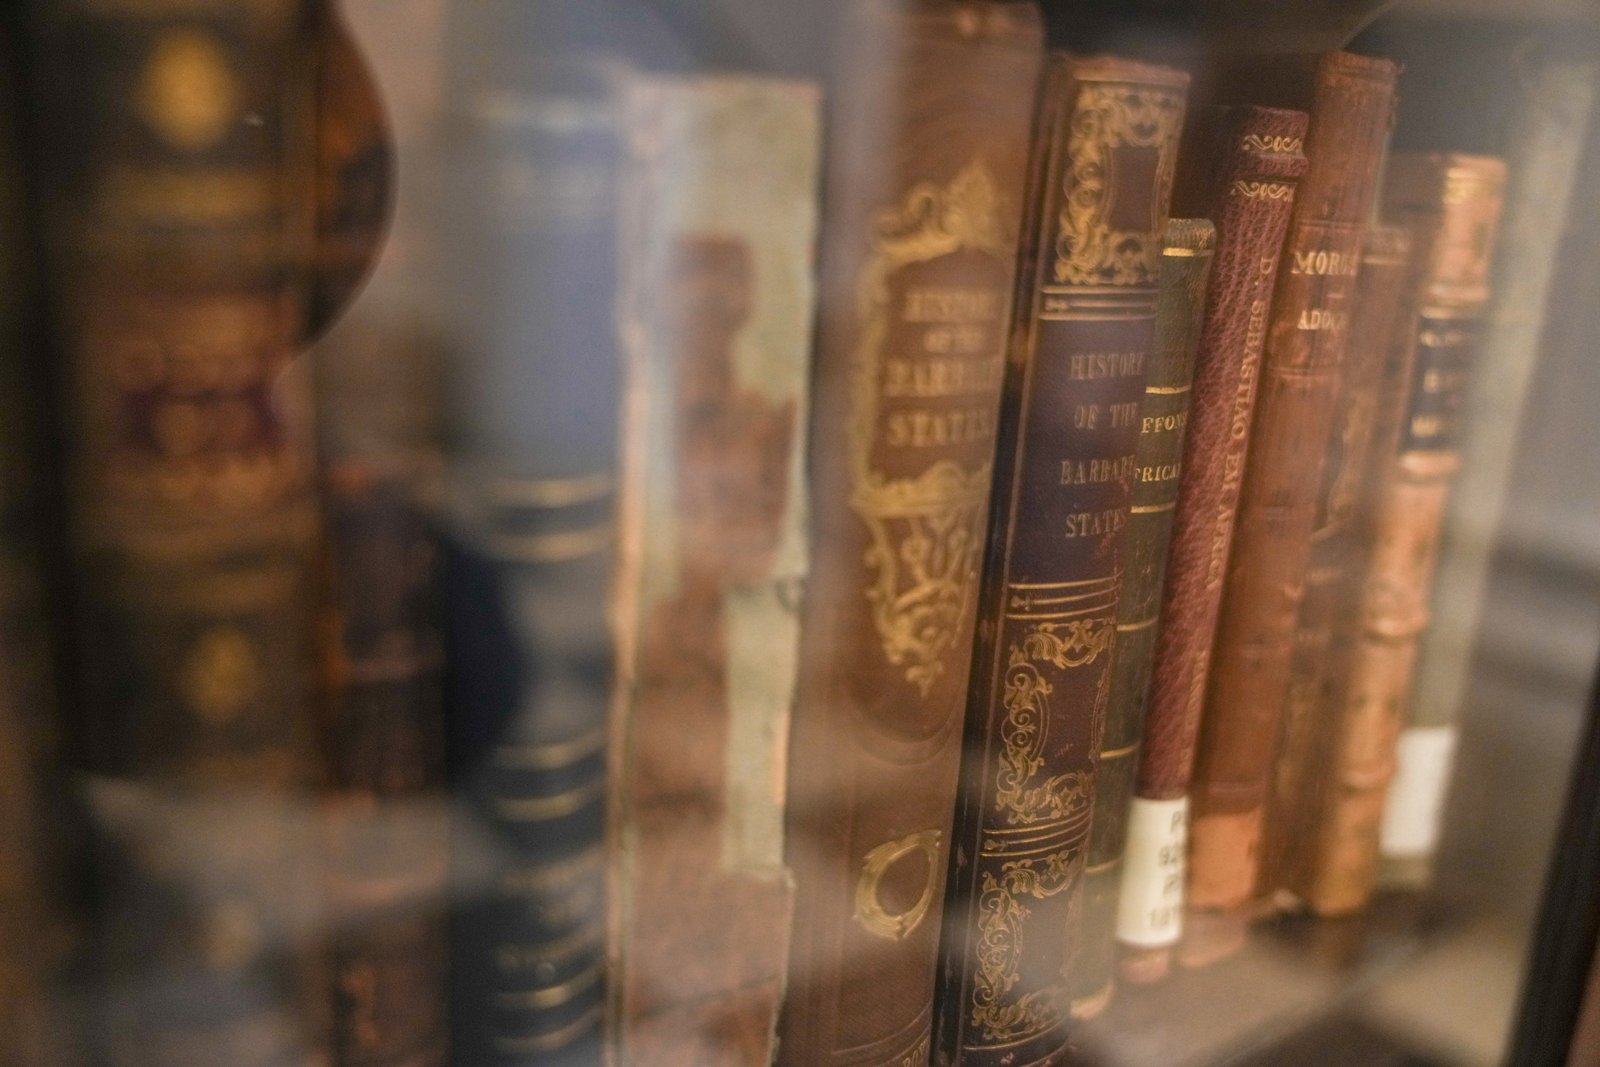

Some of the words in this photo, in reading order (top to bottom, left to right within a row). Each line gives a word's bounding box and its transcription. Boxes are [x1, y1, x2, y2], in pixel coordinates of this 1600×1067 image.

[1070, 352, 1145, 380] HISTORY
[1074, 405, 1097, 430] OF
[1065, 508, 1127, 538] STATES
